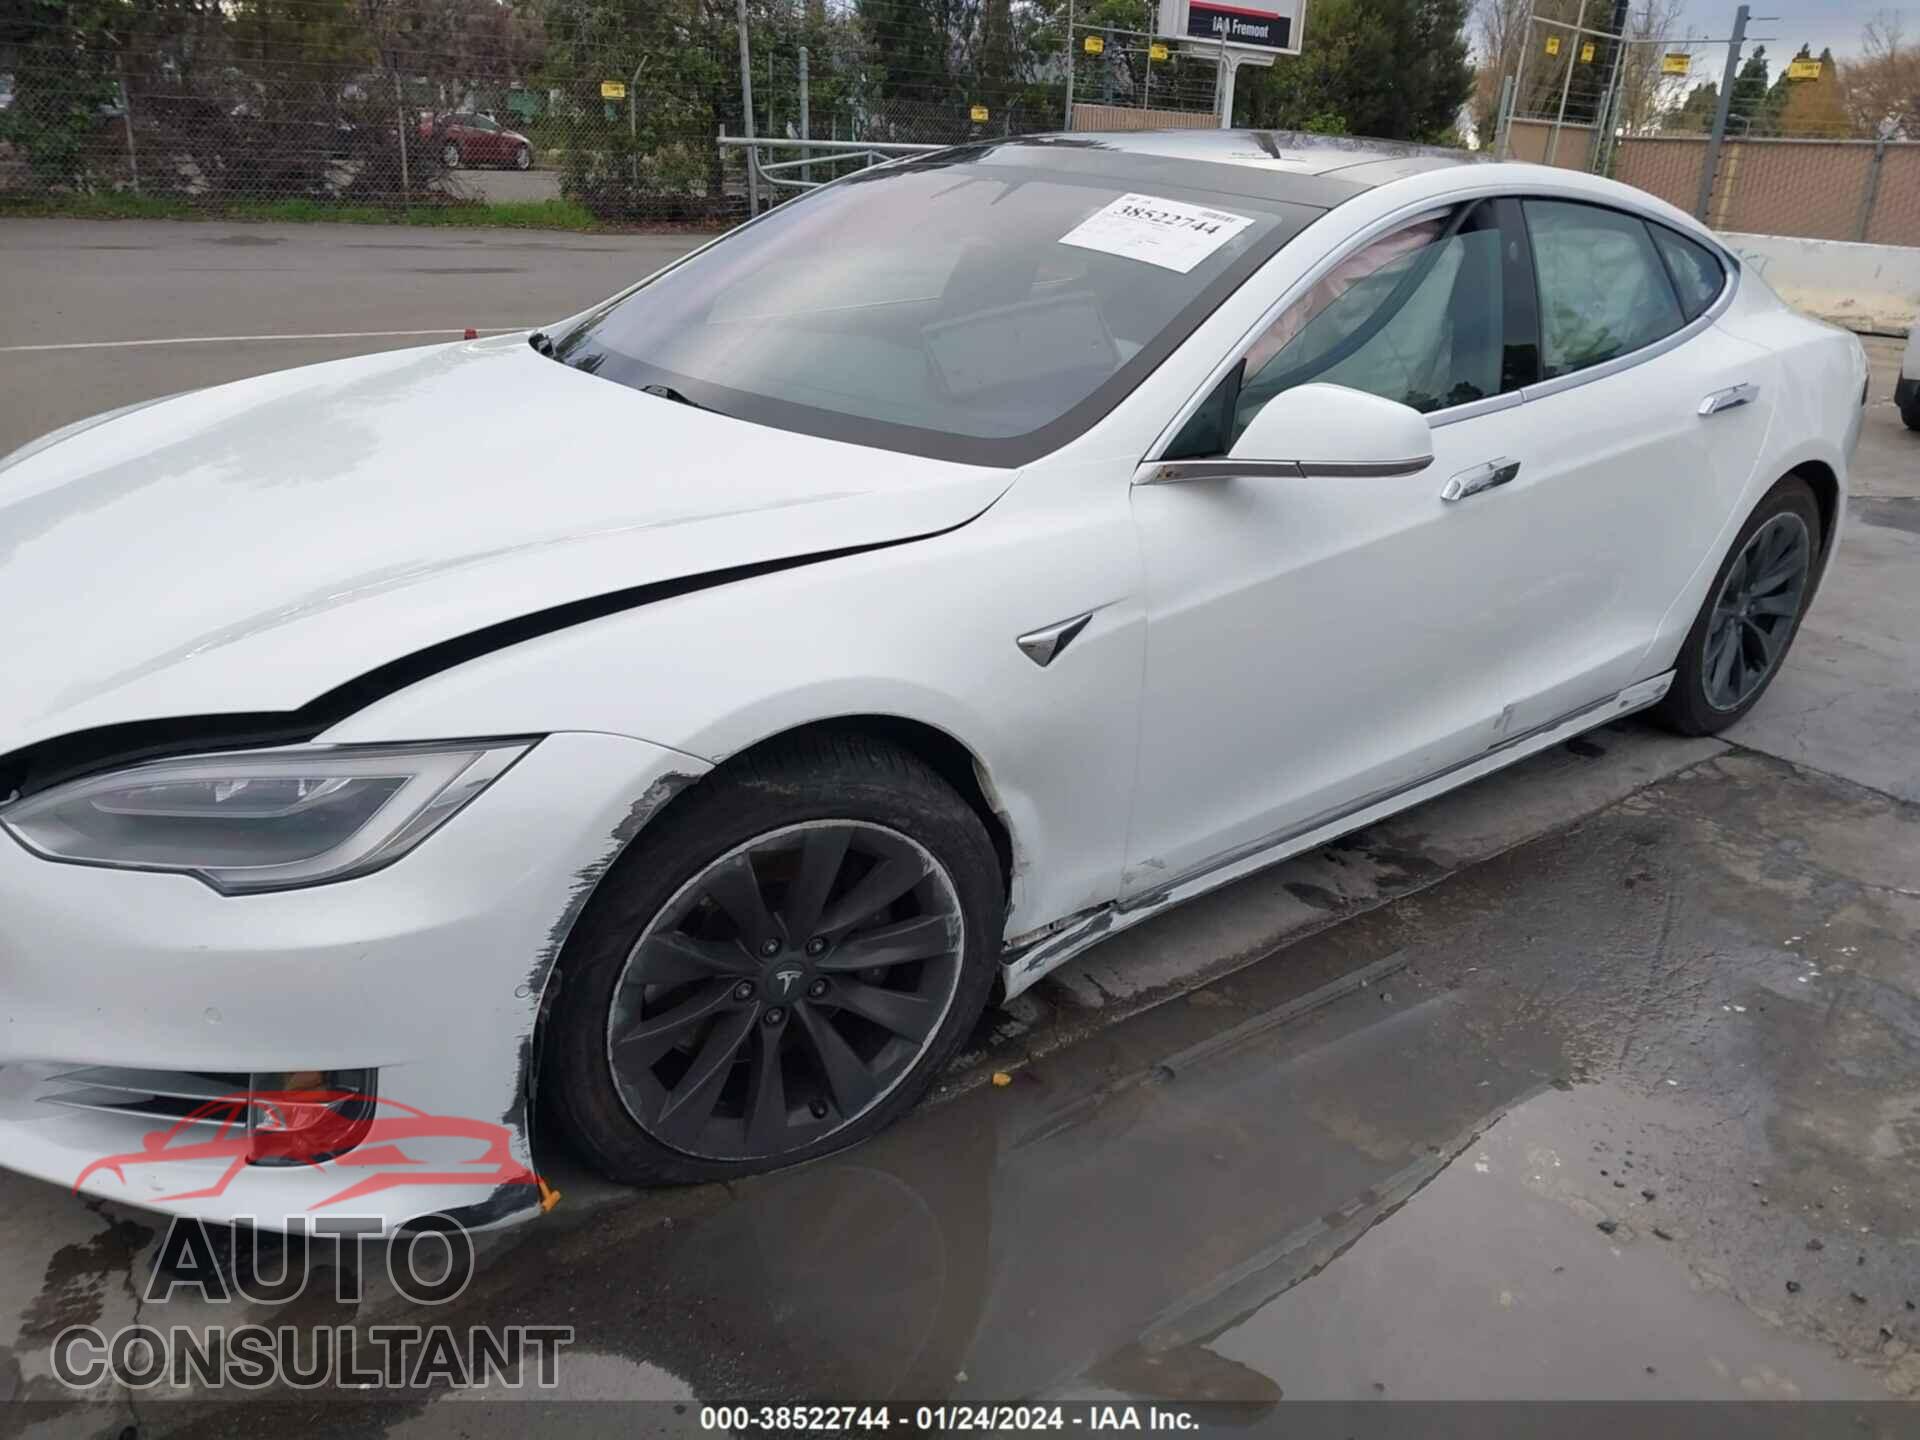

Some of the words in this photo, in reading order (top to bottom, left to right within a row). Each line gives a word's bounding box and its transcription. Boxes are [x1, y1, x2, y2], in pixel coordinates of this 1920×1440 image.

[1212, 16, 1230, 33] IAA
[1232, 18, 1269, 38] Fremont
[1113, 204, 1221, 235] 38522744
